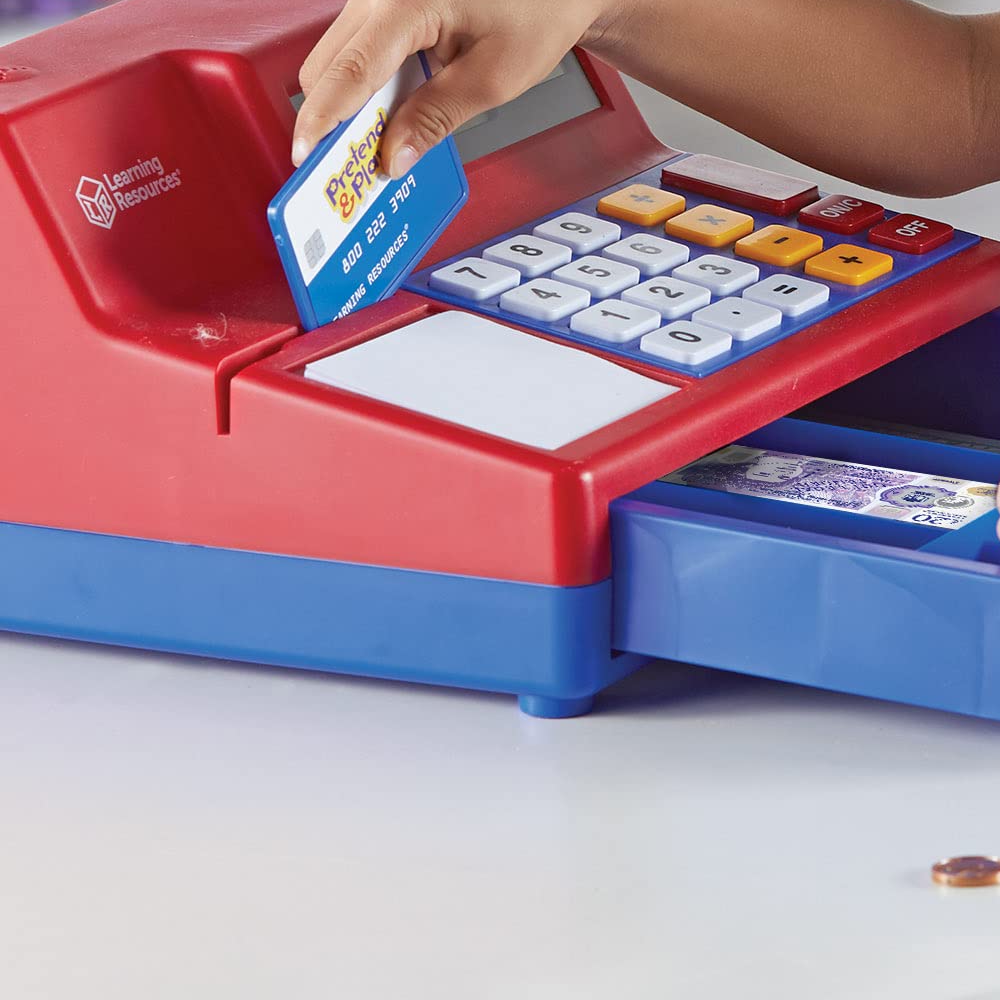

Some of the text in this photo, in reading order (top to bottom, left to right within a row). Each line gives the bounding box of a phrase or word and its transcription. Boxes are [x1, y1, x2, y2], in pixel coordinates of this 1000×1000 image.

[325, 111, 386, 206] Pretend
[103, 156, 164, 191] Learning
[339, 155, 380, 218] & Pla
[341, 174, 416, 274] 800 222 3909
[559, 221, 593, 235] 9
[895, 219, 929, 237] OFF
[509, 243, 544, 257] 8
[629, 242, 663, 256] 6
[453, 266, 488, 280] 7
[577, 264, 612, 279] 5
[698, 263, 732, 276] 3
[530, 286, 563, 300] 4
[647, 284, 685, 300] 2
[333, 283, 366, 321] ARNING
[599, 308, 632, 321] 1
[667, 330, 702, 343] 0
